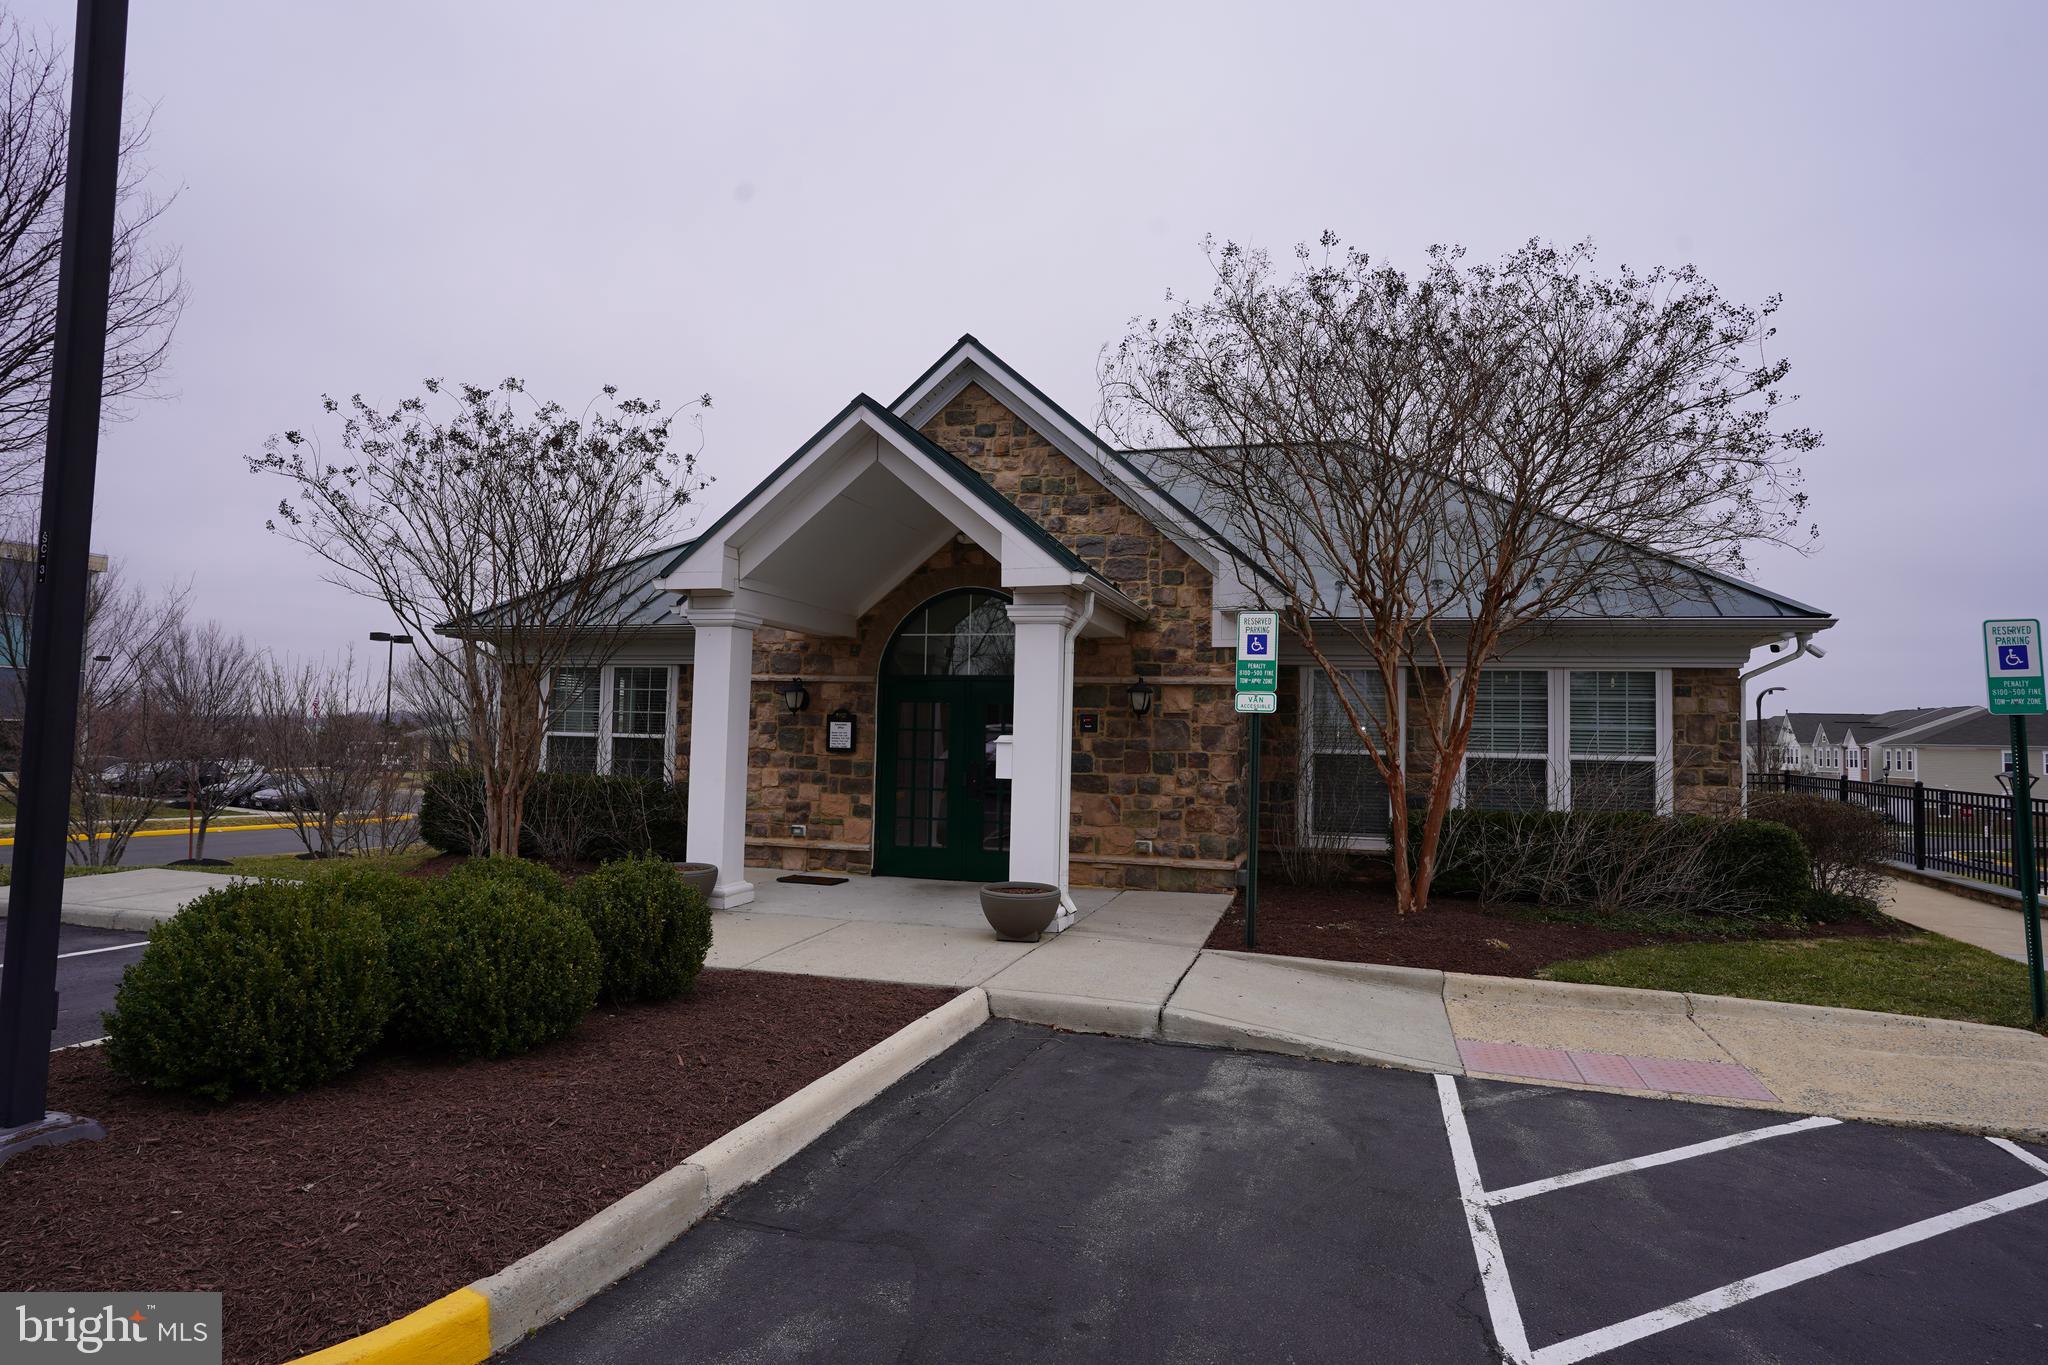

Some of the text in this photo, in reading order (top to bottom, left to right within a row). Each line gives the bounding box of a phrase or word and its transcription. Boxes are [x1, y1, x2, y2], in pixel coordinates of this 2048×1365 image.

[1243, 617, 1272, 625] RESERVED
[1245, 626, 1270, 634] PARKING
[1991, 626, 2032, 635] RESERVED
[1995, 636, 2031, 645] PARKING
[2028, 687, 2042, 695] FINE
[2027, 697, 2042, 705] ZONE
